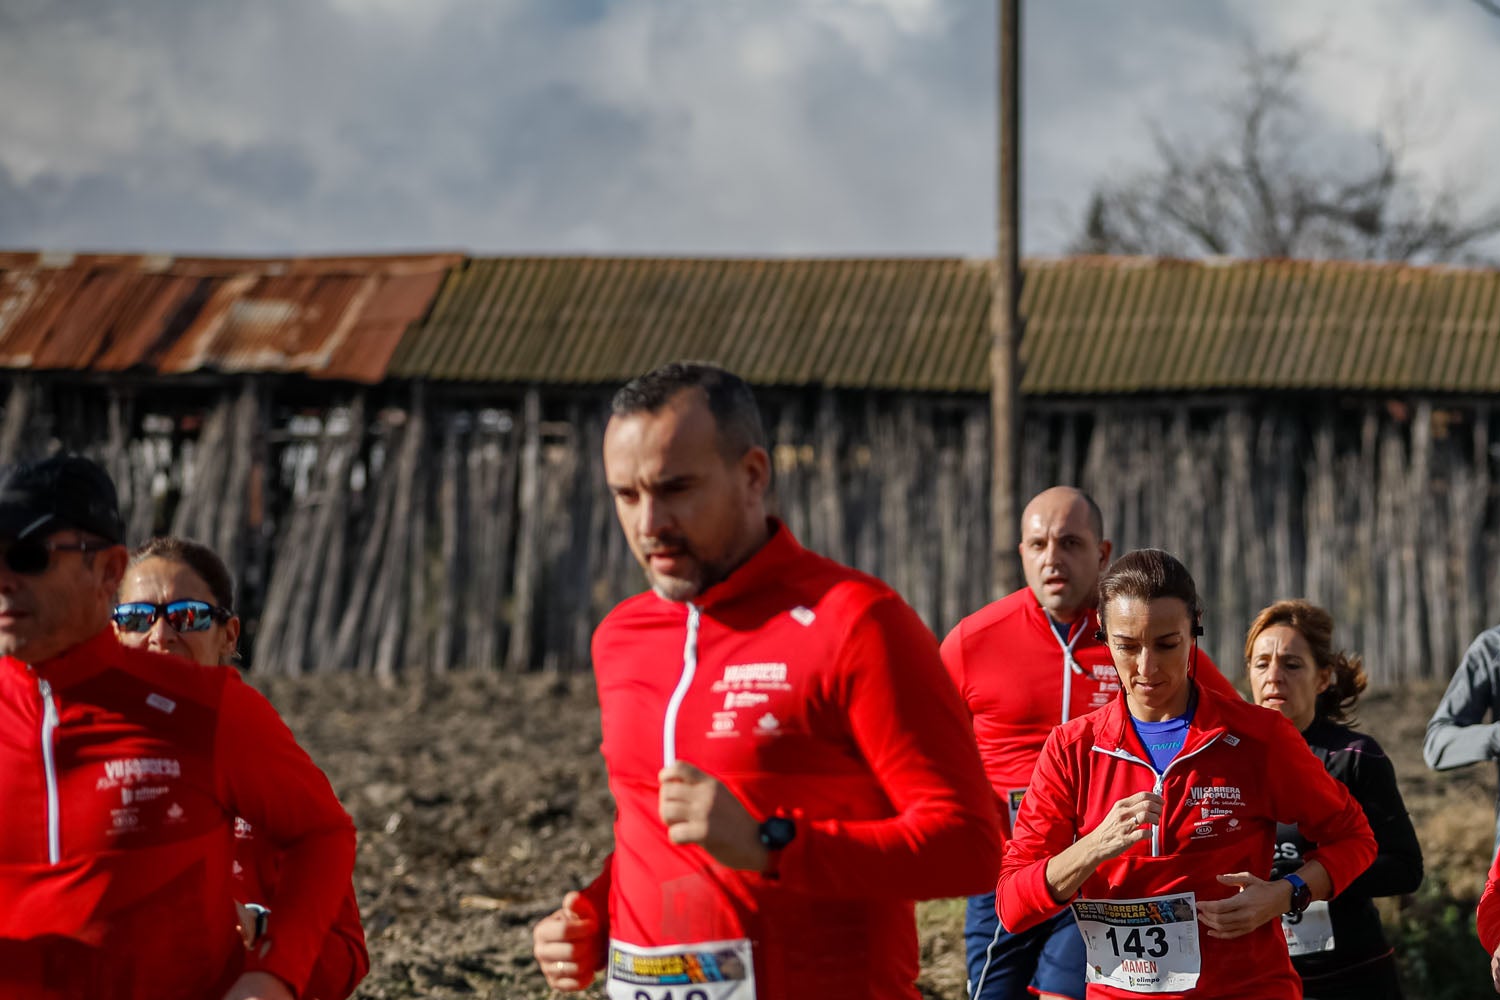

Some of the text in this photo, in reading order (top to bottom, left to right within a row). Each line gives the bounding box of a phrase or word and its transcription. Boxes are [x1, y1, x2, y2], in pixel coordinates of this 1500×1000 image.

[1190, 787, 1202, 799] VII
[1104, 904, 1145, 912] CARRERA
[1106, 927, 1169, 958] 143
[1121, 960, 1157, 973] MAMEN
[1137, 976, 1160, 984] olimpo
